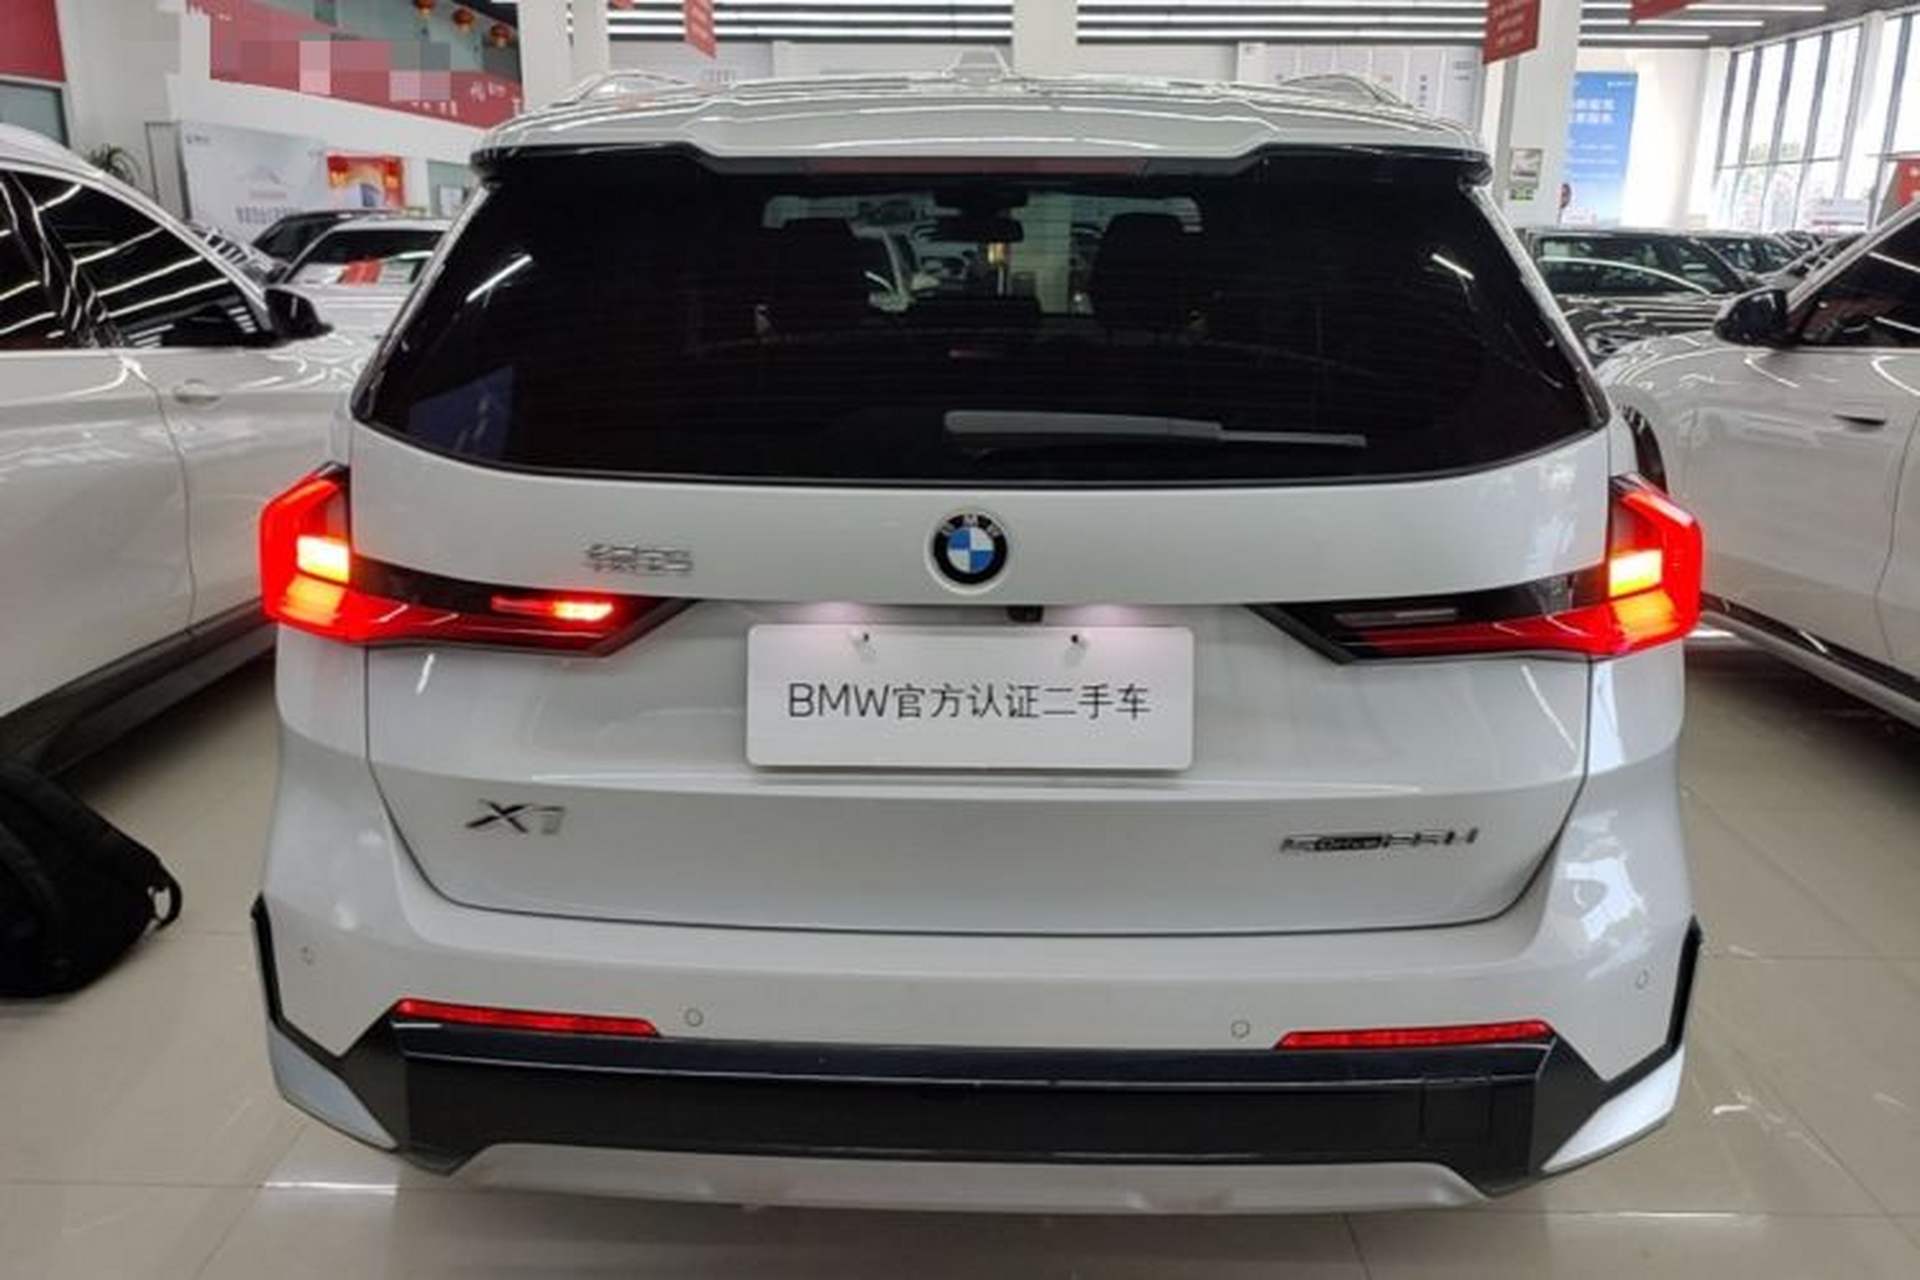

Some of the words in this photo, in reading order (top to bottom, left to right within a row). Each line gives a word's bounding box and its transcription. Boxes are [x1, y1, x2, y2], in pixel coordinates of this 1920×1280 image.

[788, 682, 1151, 721] BMW官方认证二手车
[466, 798, 566, 835] X1
